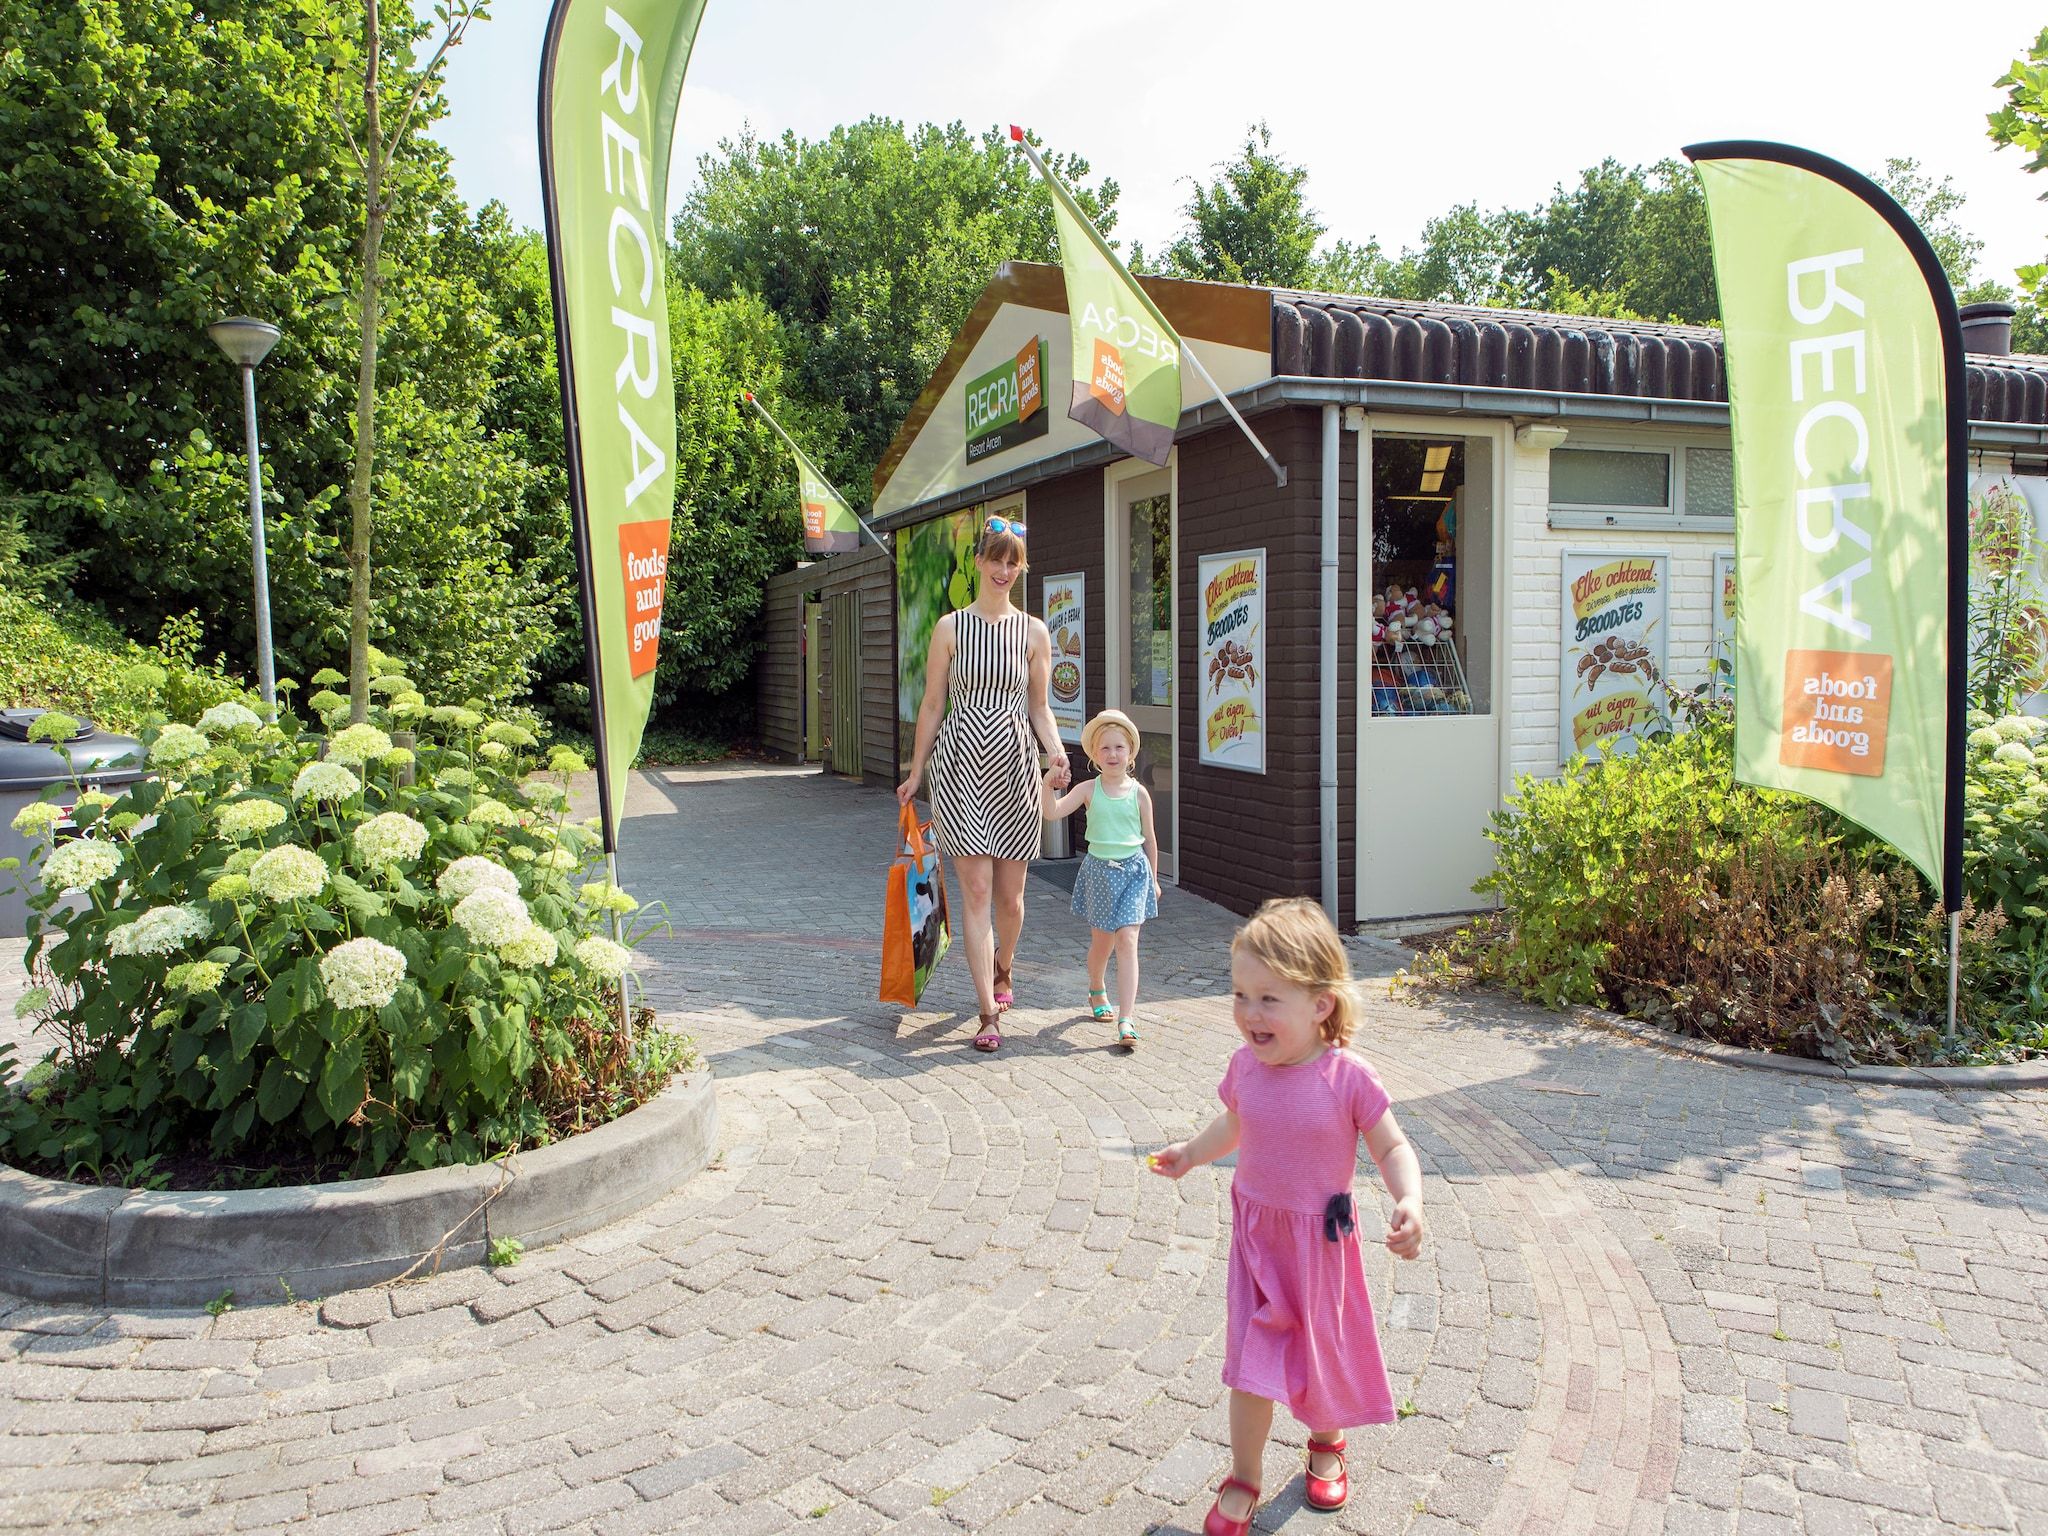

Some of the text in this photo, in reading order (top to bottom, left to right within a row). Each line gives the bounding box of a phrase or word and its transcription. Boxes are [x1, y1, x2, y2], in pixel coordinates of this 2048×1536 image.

[601, 6, 666, 510] RECRA
[1019, 354, 1036, 379] foods
[1022, 368, 1034, 391] and
[968, 371, 1020, 431] RECRA
[1021, 382, 1039, 411] goods
[969, 435, 1002, 459] Resort Arcen
[627, 548, 666, 582] foods
[636, 579, 661, 612] and
[1207, 575, 1224, 608] Elke
[1575, 569, 1602, 603] Elke
[1207, 604, 1249, 646] BROODJES
[1575, 601, 1643, 642] BROODJES
[1226, 703, 1246, 726] eigen
[1606, 697, 1639, 720] eigen
